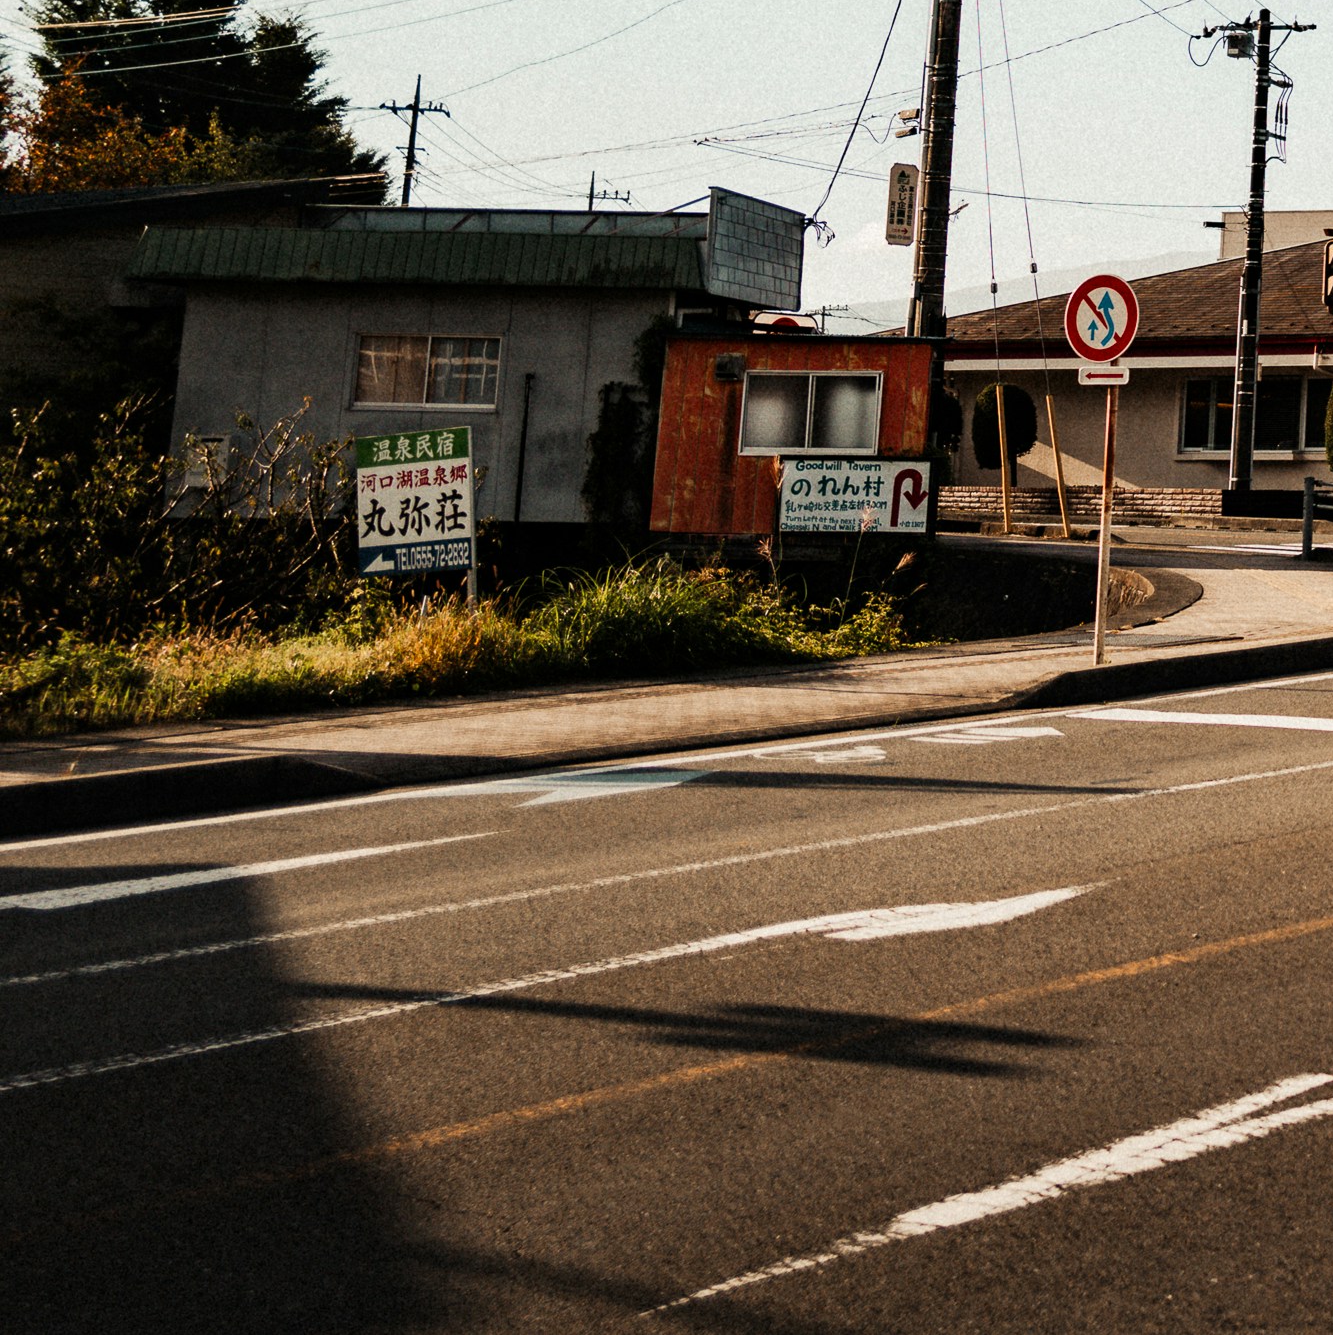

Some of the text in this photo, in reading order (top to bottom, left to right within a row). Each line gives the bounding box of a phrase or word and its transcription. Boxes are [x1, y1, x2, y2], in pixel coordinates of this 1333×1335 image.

[373, 432, 455, 462] 温泉民宿
[846, 460, 881, 472] Tavern
[360, 464, 468, 494] 河口湖温泉郷
[790, 475, 885, 498] のれん村
[360, 488, 468, 539] 丸弥荘
[785, 515, 802, 523] Turn
[803, 515, 817, 523] Left
[840, 517, 856, 525] next
[839, 523, 856, 531] walk
